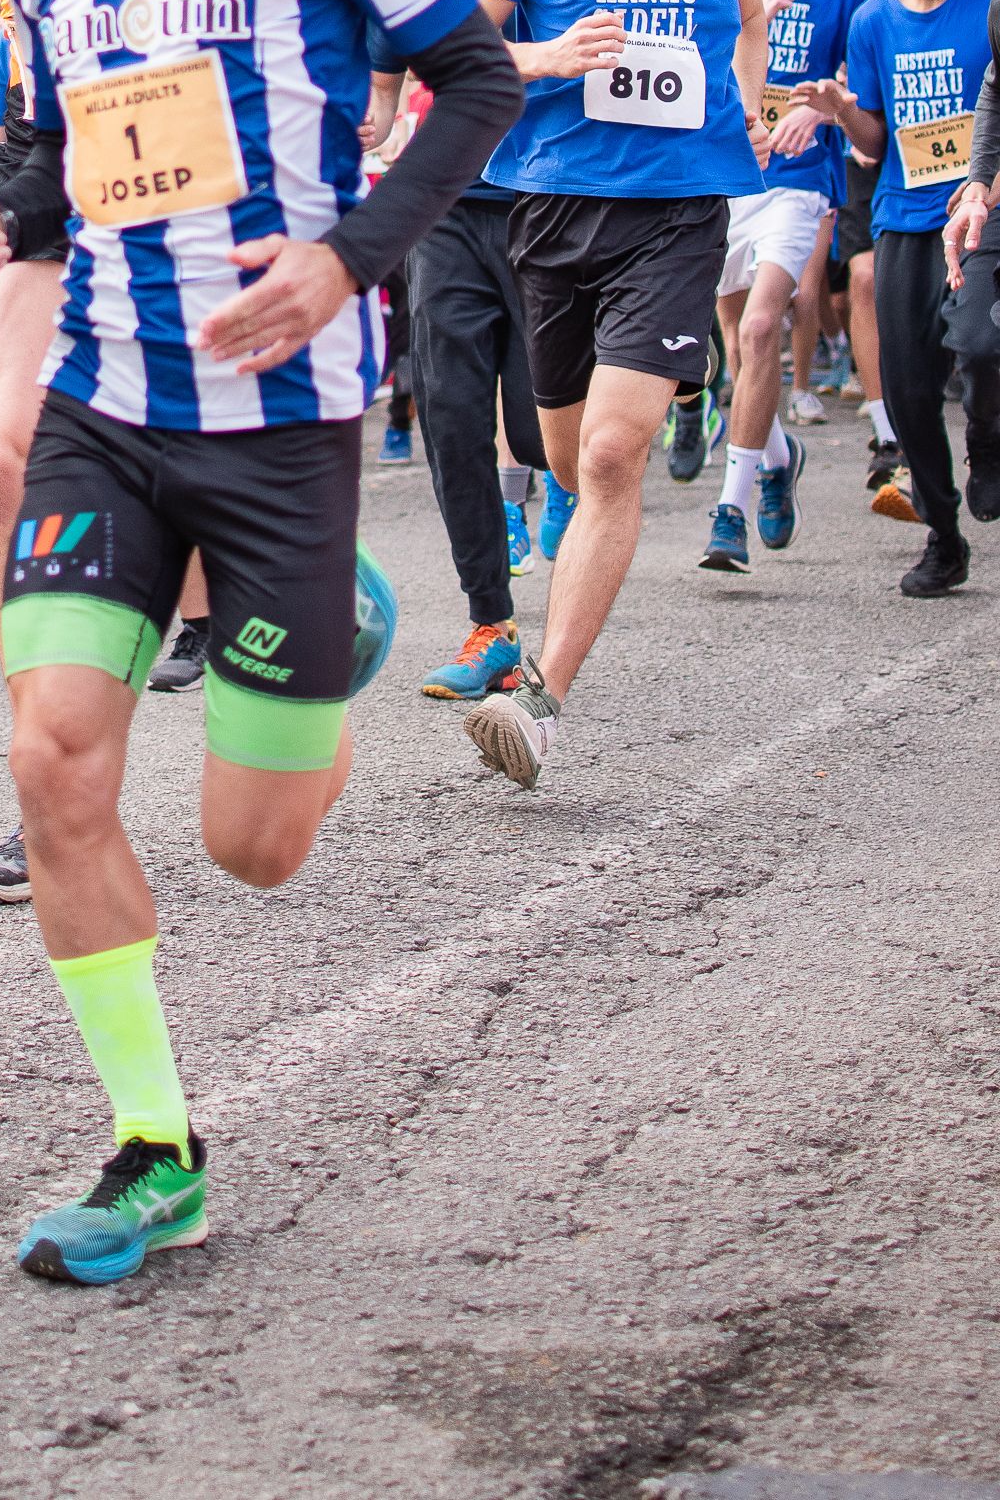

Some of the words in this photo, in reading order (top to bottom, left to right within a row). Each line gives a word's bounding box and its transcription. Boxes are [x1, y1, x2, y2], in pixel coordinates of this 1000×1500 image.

[768, 18, 815, 48] NAU
[895, 49, 955, 71] INSTITUT
[86, 95, 118, 114] MILLA
[125, 83, 182, 105] ADULTS
[609, 66, 683, 103] 810
[893, 68, 963, 99] ARNAU
[124, 124, 142, 161] 1
[914, 130, 936, 139] MILLA
[938, 123, 965, 135] ADULTS
[931, 139, 958, 158] 84
[910, 163, 949, 178] DEREK
[953, 157, 971, 168] DA
[101, 168, 193, 204] JOSEP
[222, 645, 294, 684] INVERSE
